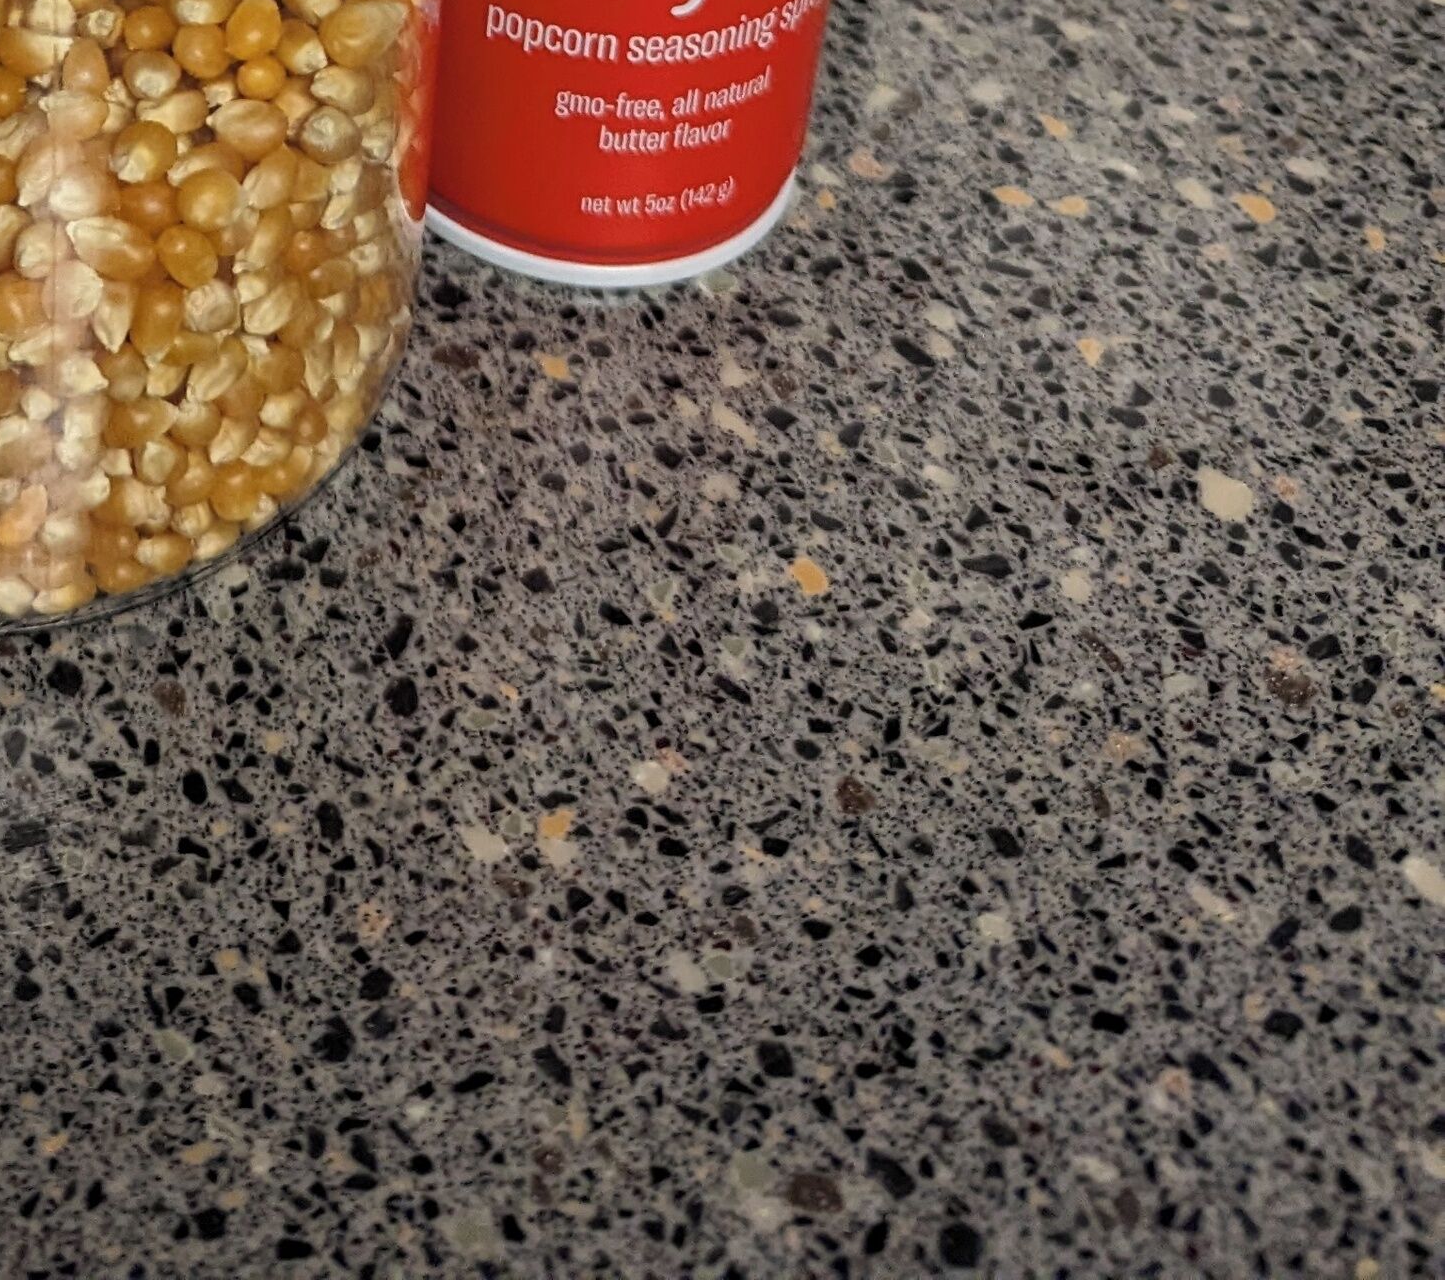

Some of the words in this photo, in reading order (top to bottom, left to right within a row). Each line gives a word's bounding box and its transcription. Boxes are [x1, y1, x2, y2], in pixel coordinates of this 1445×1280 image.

[486, 3, 618, 61] popcorn
[626, 6, 777, 63] seasoning
[554, 90, 666, 121] gmo-free,
[671, 88, 701, 117] all
[703, 64, 772, 112] natural
[599, 124, 670, 153] butter
[673, 119, 732, 148] flavor
[581, 195, 612, 215] net
[616, 195, 641, 216] wt
[644, 193, 676, 217] 5oz
